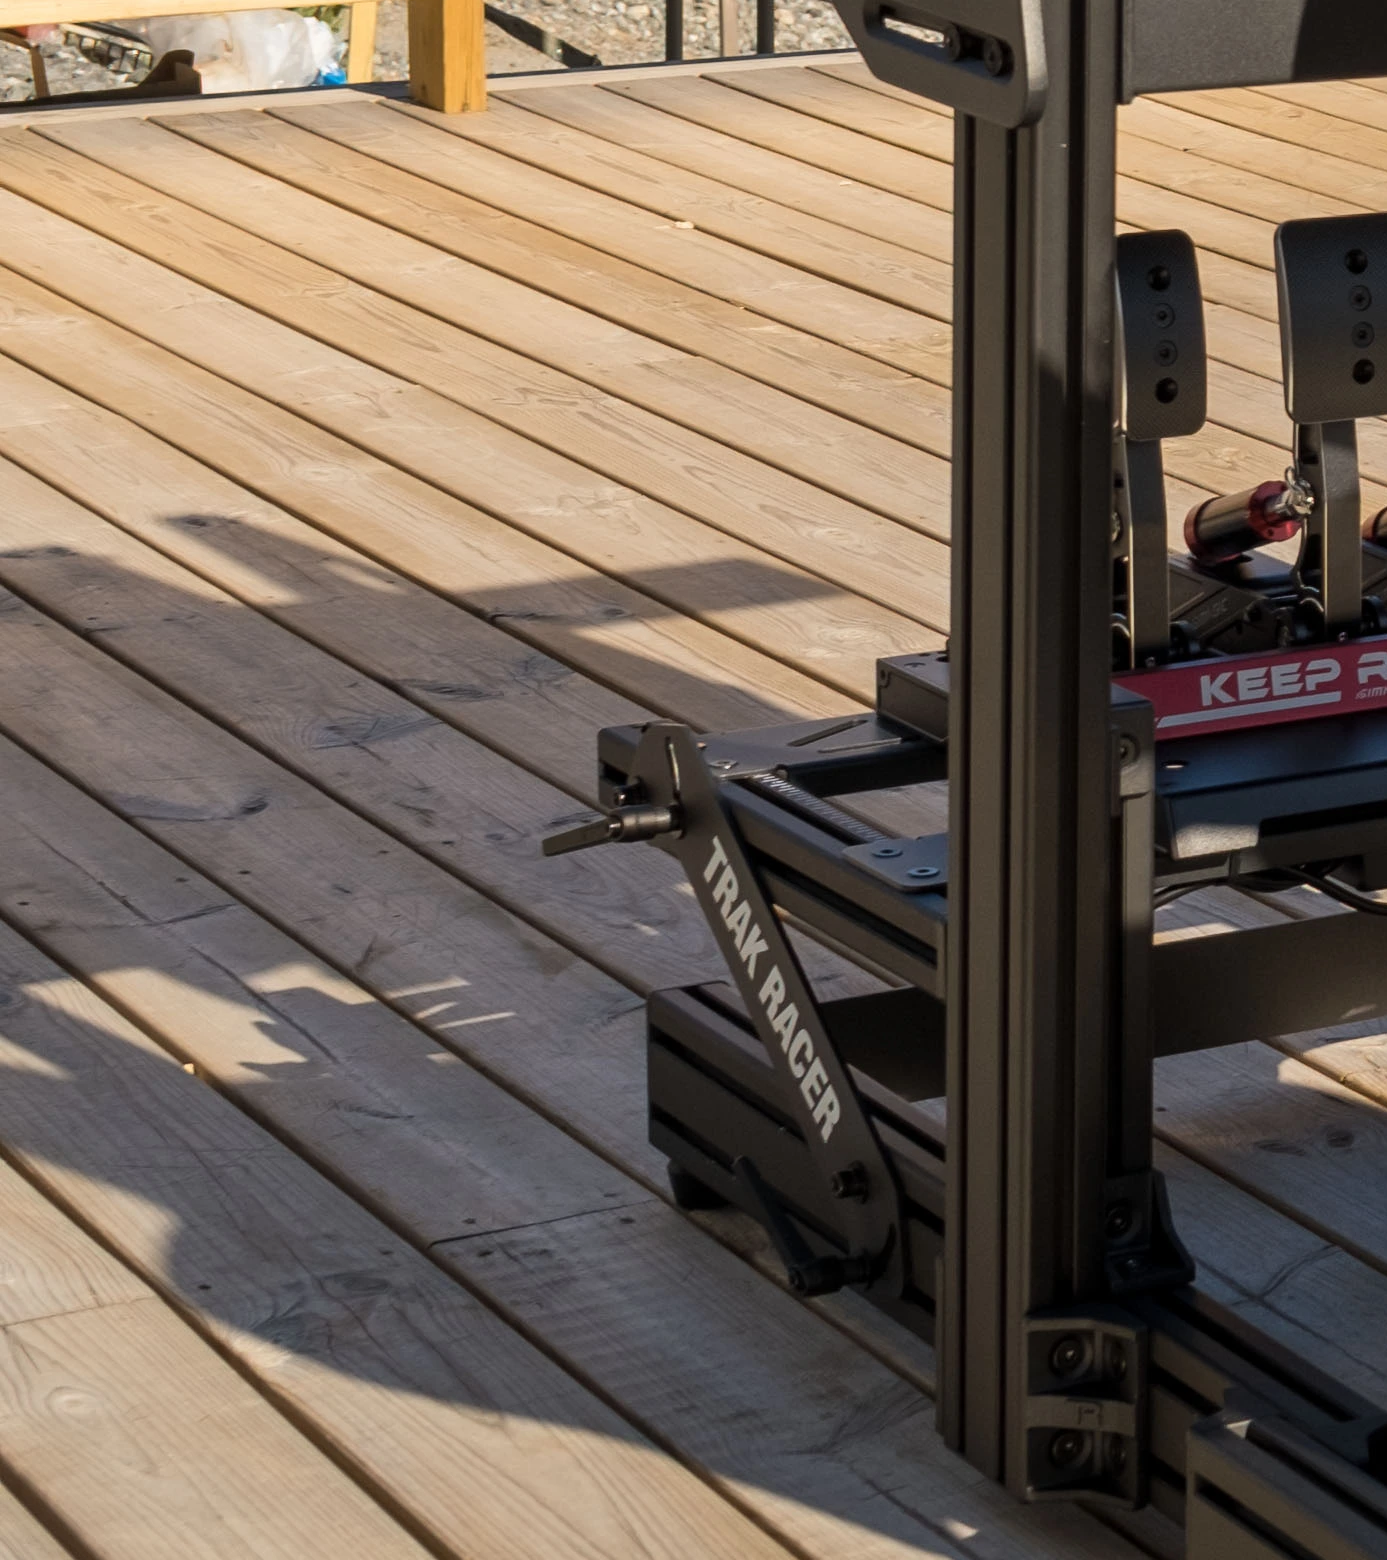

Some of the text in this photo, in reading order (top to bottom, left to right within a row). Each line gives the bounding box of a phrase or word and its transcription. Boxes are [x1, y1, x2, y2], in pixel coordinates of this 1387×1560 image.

[1201, 657, 1342, 707] KEEP
[703, 835, 841, 1144] TRAK RACER
